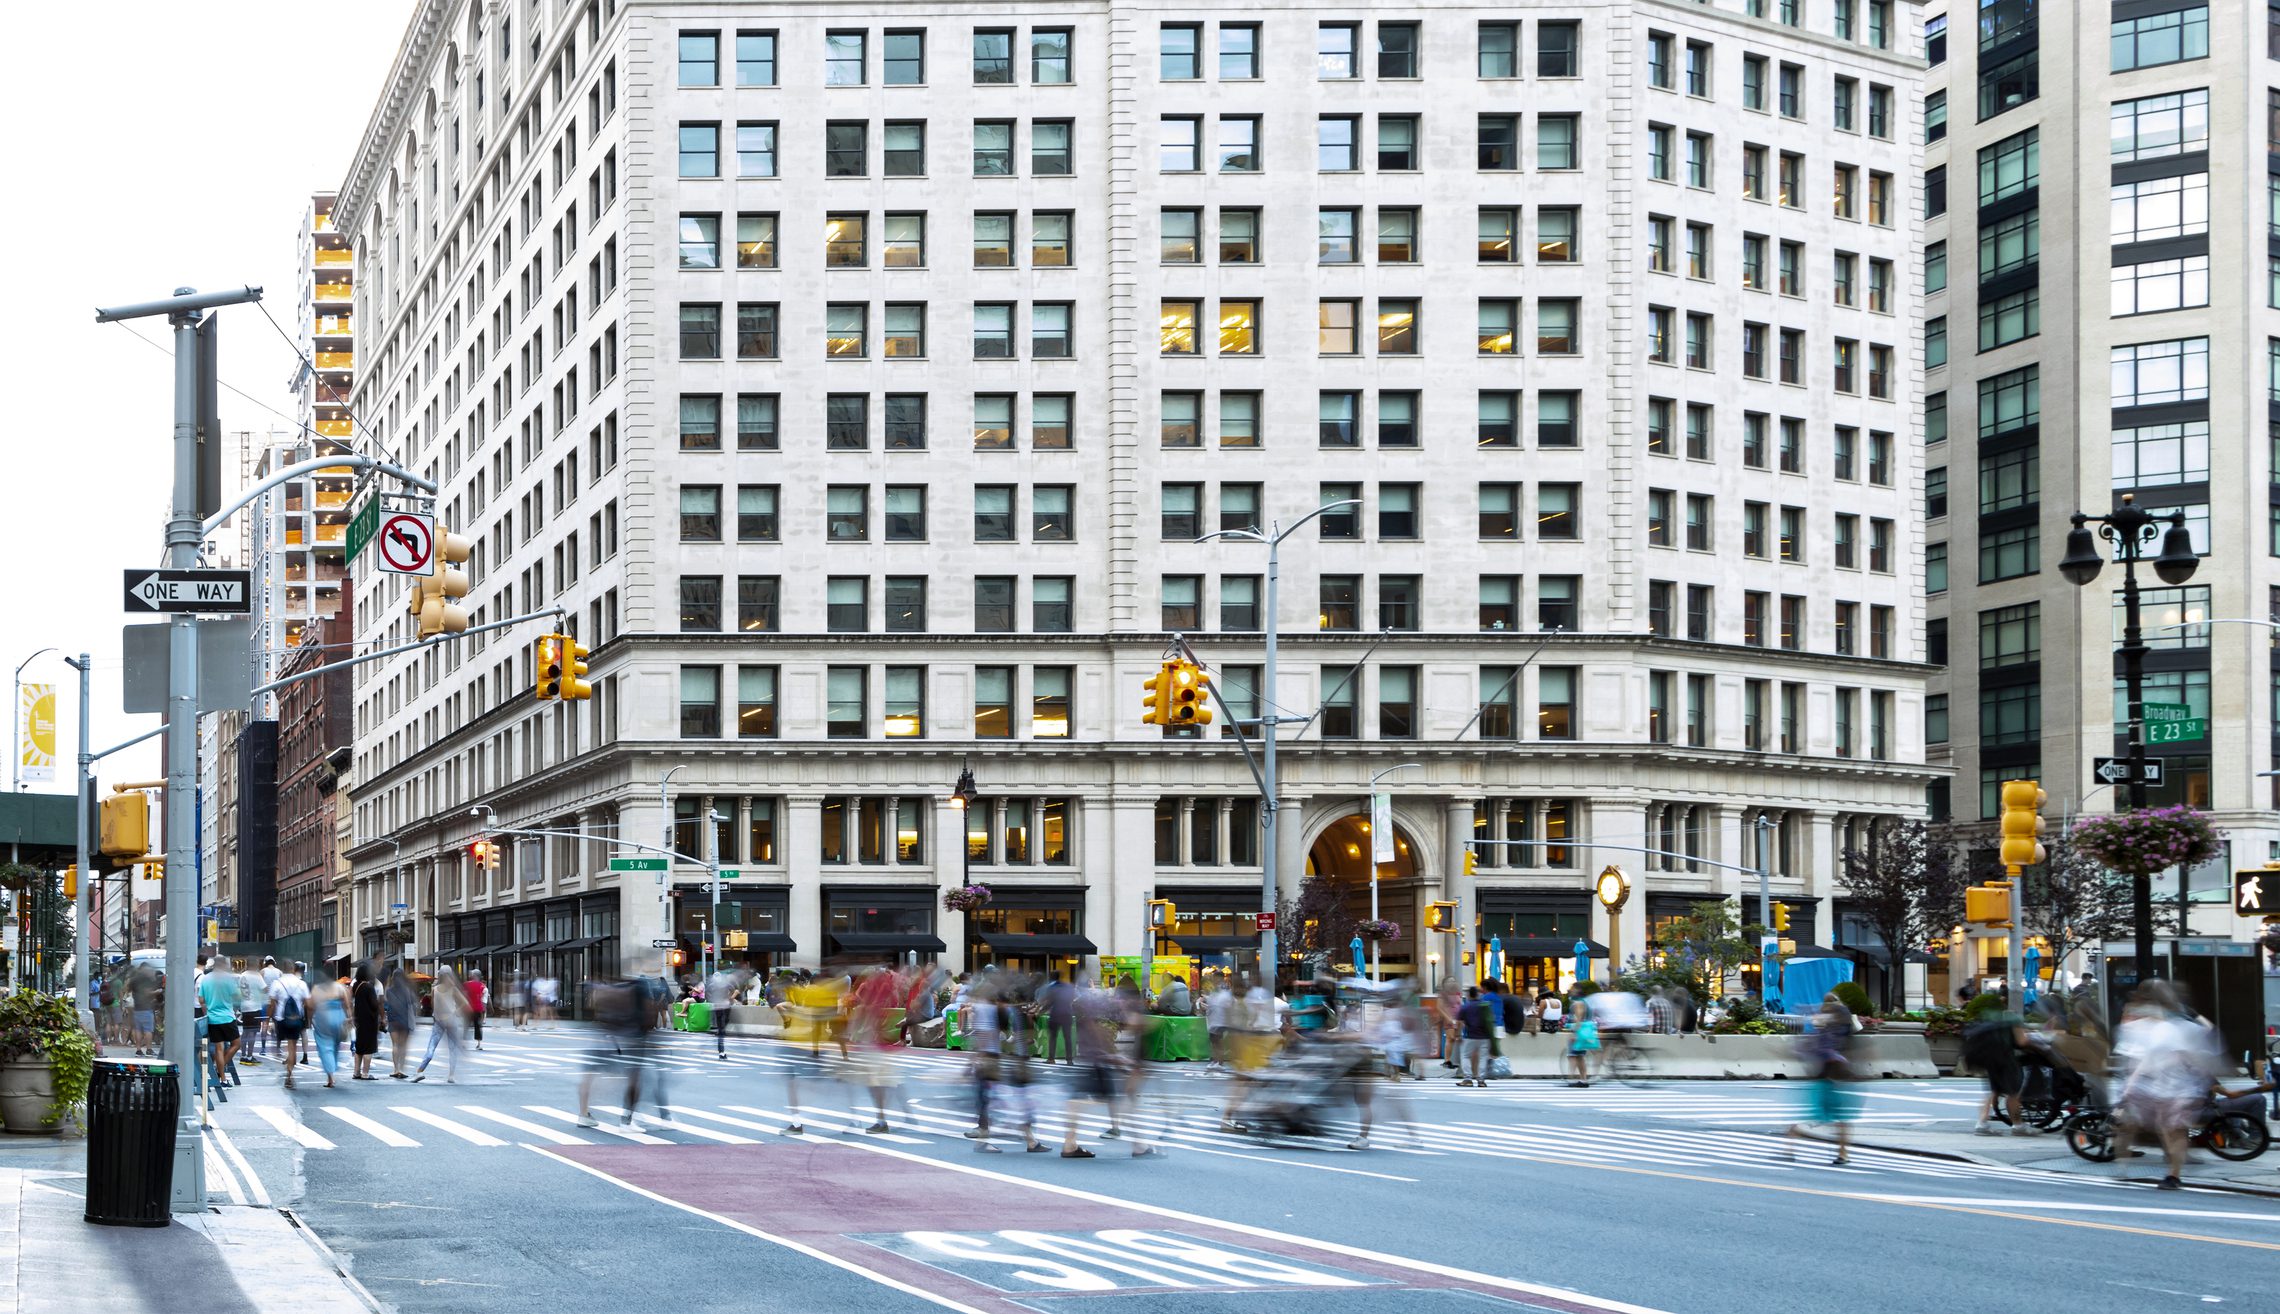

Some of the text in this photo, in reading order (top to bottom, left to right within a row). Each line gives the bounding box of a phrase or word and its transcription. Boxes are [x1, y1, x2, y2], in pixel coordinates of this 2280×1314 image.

[354, 506, 372, 549] E 23 St
[144, 583, 234, 600] ONE WAY
[2144, 705, 2186, 720] Broadway
[2150, 722, 2197, 741] E 23 St
[2104, 766, 2125, 777] ONE
[629, 861, 648, 870] 5 Av
[902, 1230, 1368, 1290] BUS
